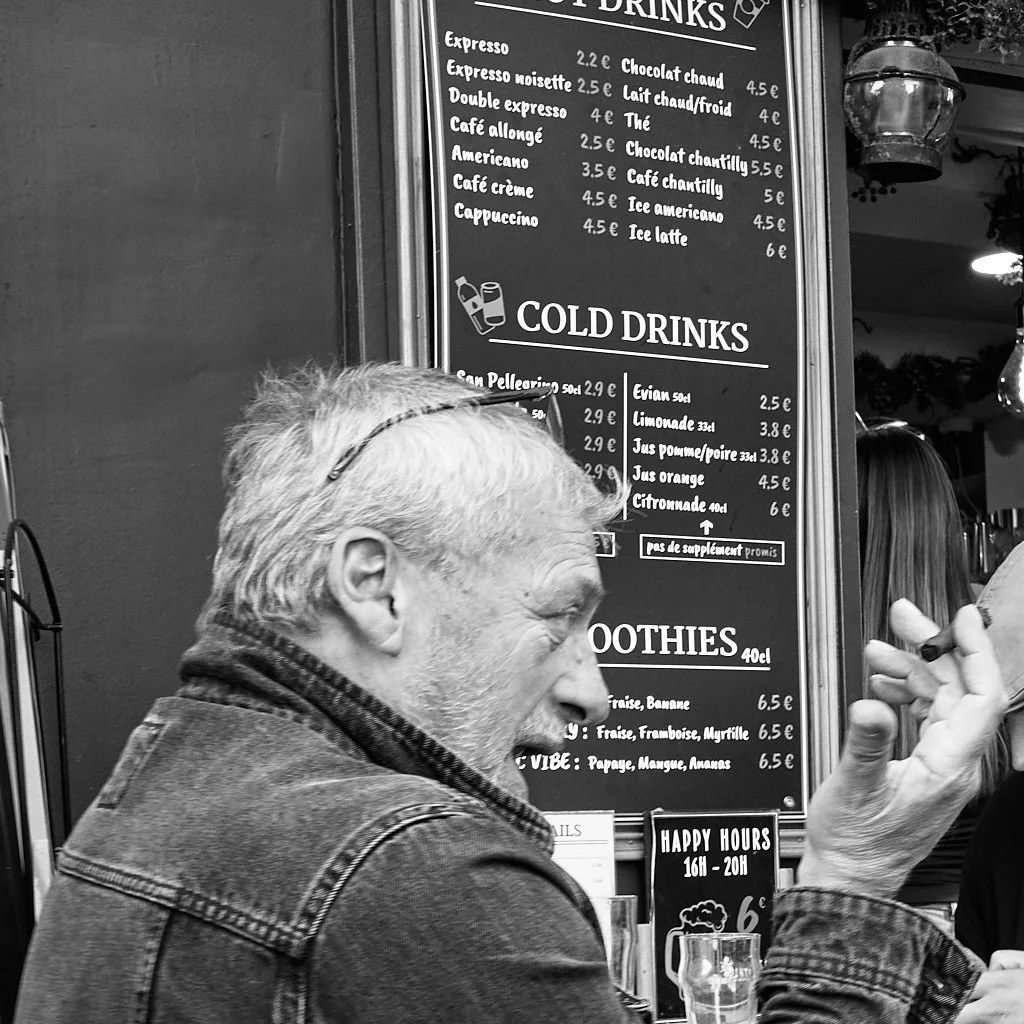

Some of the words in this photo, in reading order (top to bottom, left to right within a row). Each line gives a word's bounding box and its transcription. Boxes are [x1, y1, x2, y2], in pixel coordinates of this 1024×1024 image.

[445, 31, 509, 54] Expresso
[447, 59, 510, 83] Expresso
[515, 71, 571, 92] noisette
[622, 58, 681, 81] Chocolat
[684, 69, 724, 89] chaud
[449, 87, 500, 109] Double
[504, 100, 567, 118] expresso
[623, 85, 651, 103] Lait
[654, 91, 732, 117] chaud/froid
[450, 116, 484, 135] Café
[489, 121, 542, 146] allongé
[624, 112, 650, 131] Thé
[452, 145, 528, 169] Americano
[626, 141, 686, 163] Chocolat
[689, 150, 748, 177] chantilly
[453, 174, 487, 193] Café
[491, 179, 533, 198] crème
[627, 168, 659, 187] Café
[662, 173, 723, 200] chantilly
[454, 203, 538, 227] Cappuccino
[628, 196, 650, 213] Ice
[655, 204, 723, 223] americano
[629, 224, 651, 241] Ice
[655, 226, 687, 246] latte
[517, 301, 613, 338] COLD
[621, 311, 749, 352] DRINKS
[487, 371, 559, 394] Pellegrio
[562, 384, 581, 395] 50cl
[633, 384, 670, 401] Evian
[672, 392, 690, 403] 50cl
[633, 411, 694, 431] Limonade
[697, 421, 715, 432] 33cl
[633, 438, 655, 455] Jus
[659, 444, 737, 464] pomme/poire
[740, 452, 756, 462] 33cl
[633, 465, 656, 482] Jus
[659, 472, 704, 488] orange
[633, 493, 706, 512] Citronnade
[709, 503, 727, 513] 40cl
[646, 541, 666, 555] pas
[667, 541, 680, 553] de
[682, 542, 742, 561] supplément
[744, 545, 778, 560] promis
[587, 622, 738, 657] OOTHIES
[741, 648, 770, 664] 40cl
[647, 696, 690, 710] Banane
[596, 725, 636, 741] Fraise,
[639, 725, 701, 741] Framboise,
[704, 726, 749, 743] Myrtille
[531, 752, 570, 770] VIBE
[588, 756, 635, 773] Papaye,
[638, 756, 687, 773] Mangue,
[689, 757, 730, 770] Ananas
[661, 829, 711, 853] HAPPY
[720, 828, 770, 851] HOURS
[684, 856, 707, 877] 16H
[724, 855, 747, 876] 20H
